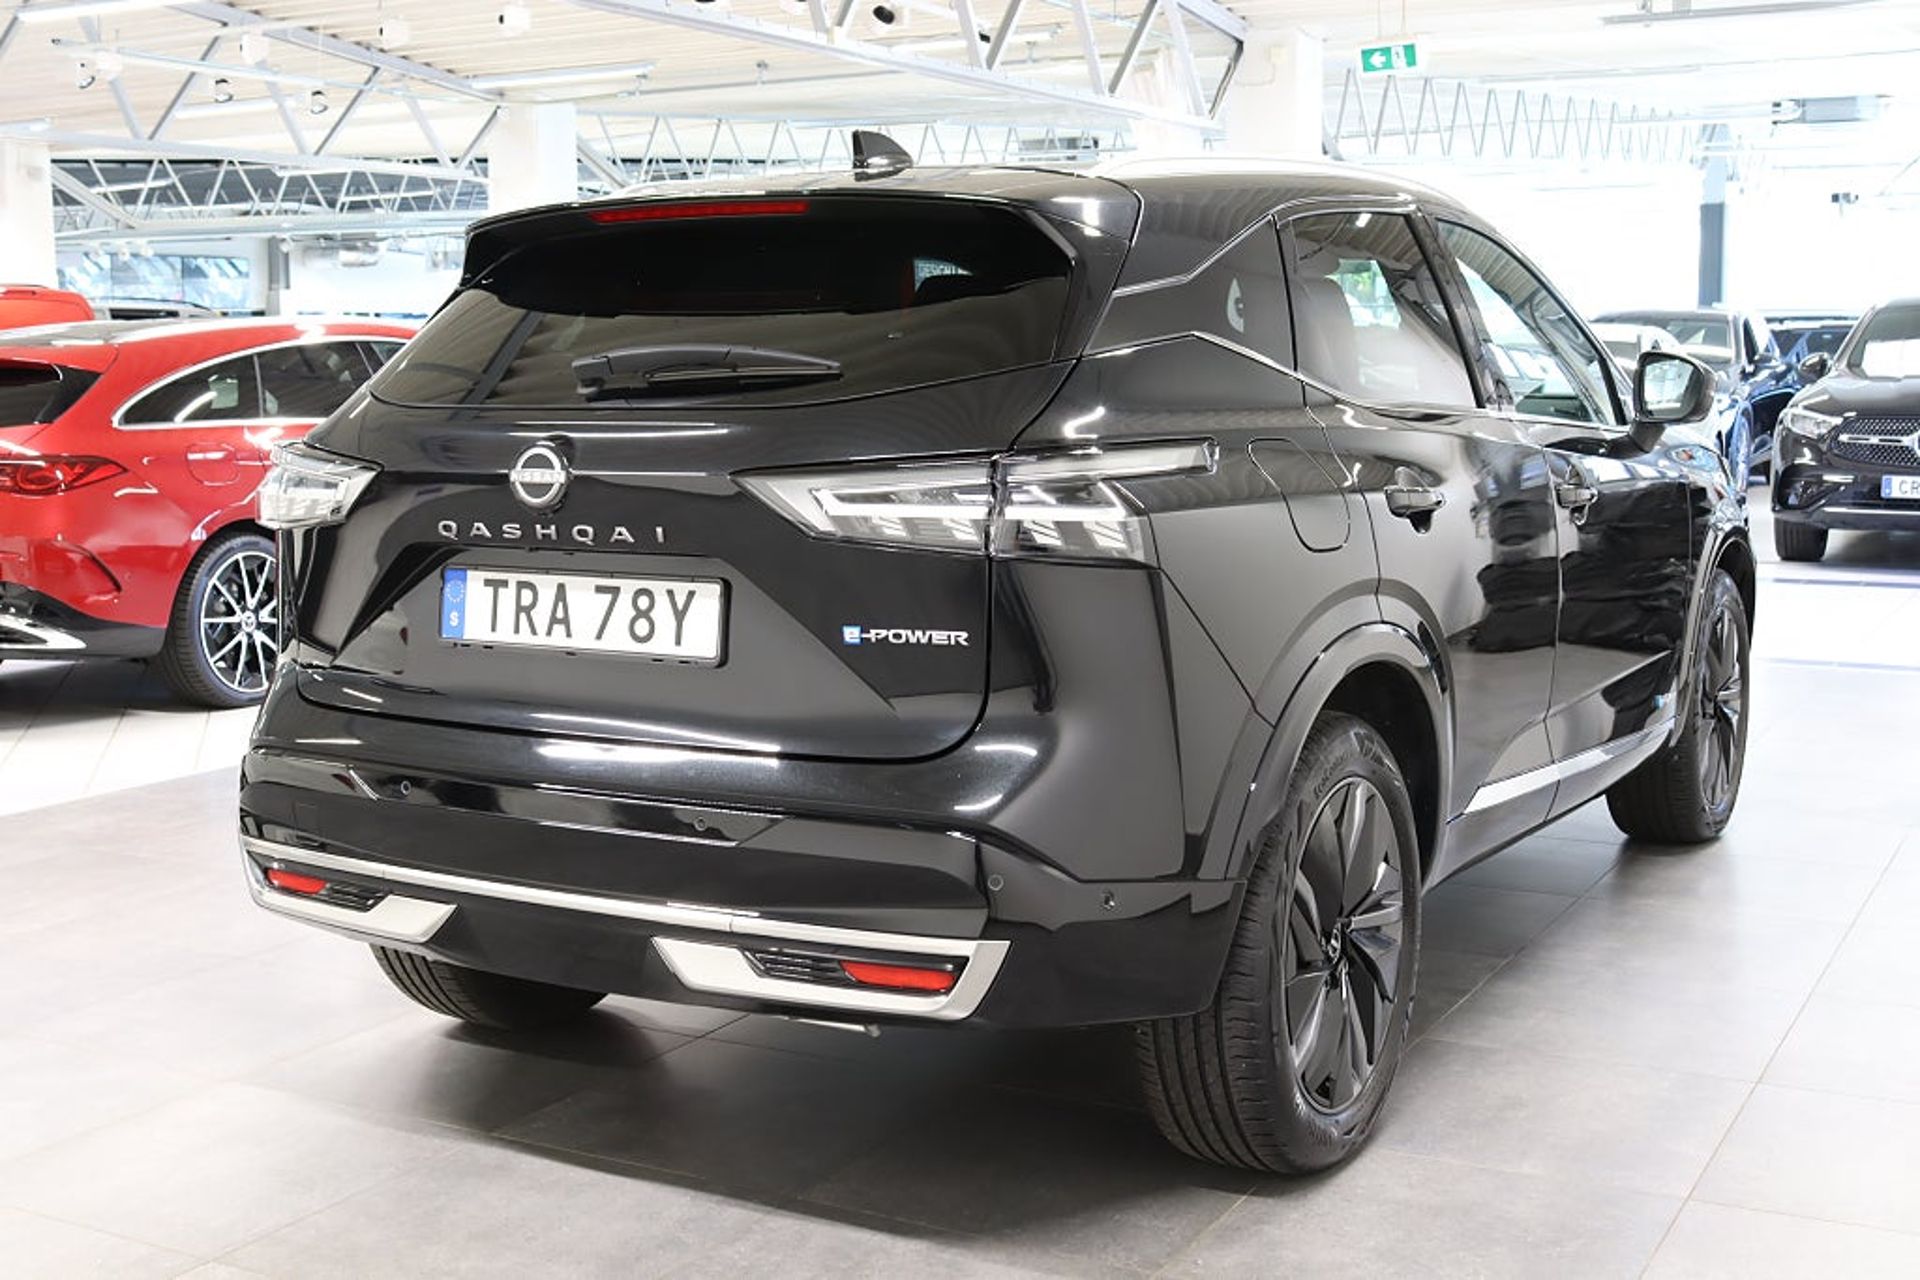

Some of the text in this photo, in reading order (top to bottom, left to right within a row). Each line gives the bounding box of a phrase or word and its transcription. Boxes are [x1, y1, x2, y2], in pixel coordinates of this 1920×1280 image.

[438, 520, 664, 546] QASHQAI
[449, 611, 459, 627] S
[483, 578, 696, 647] TRA 78Y
[843, 626, 969, 646] e-POWER
